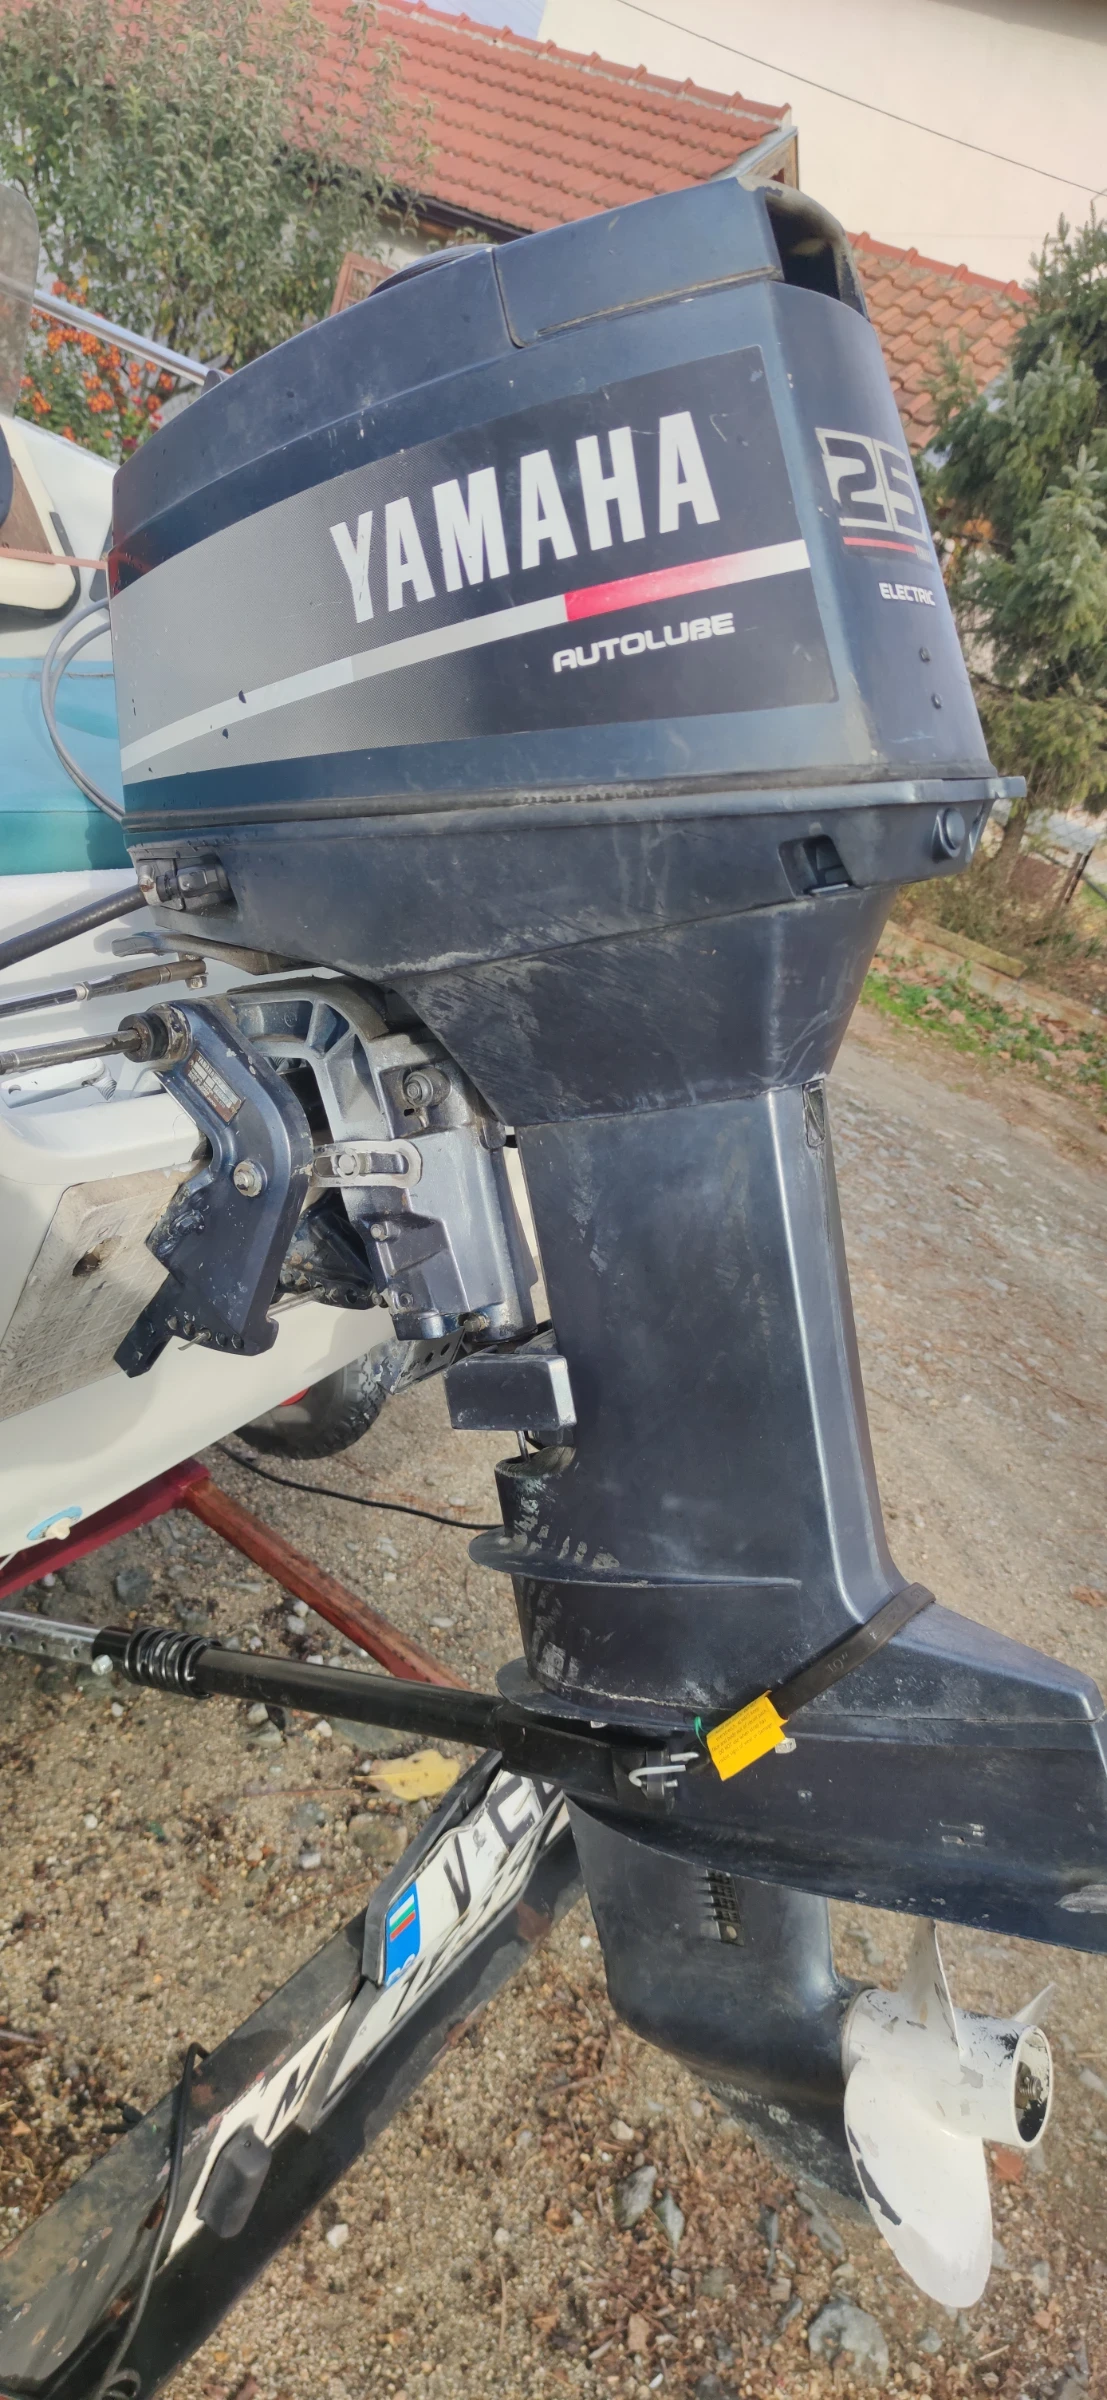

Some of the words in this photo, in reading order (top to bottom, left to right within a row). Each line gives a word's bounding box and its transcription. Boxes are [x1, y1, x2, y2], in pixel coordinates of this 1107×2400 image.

[329, 411, 721, 624] YAMAHA
[818, 430, 926, 541] 25
[878, 582, 936, 606] ELECTRIC
[552, 612, 735, 673] AUTOLUBE
